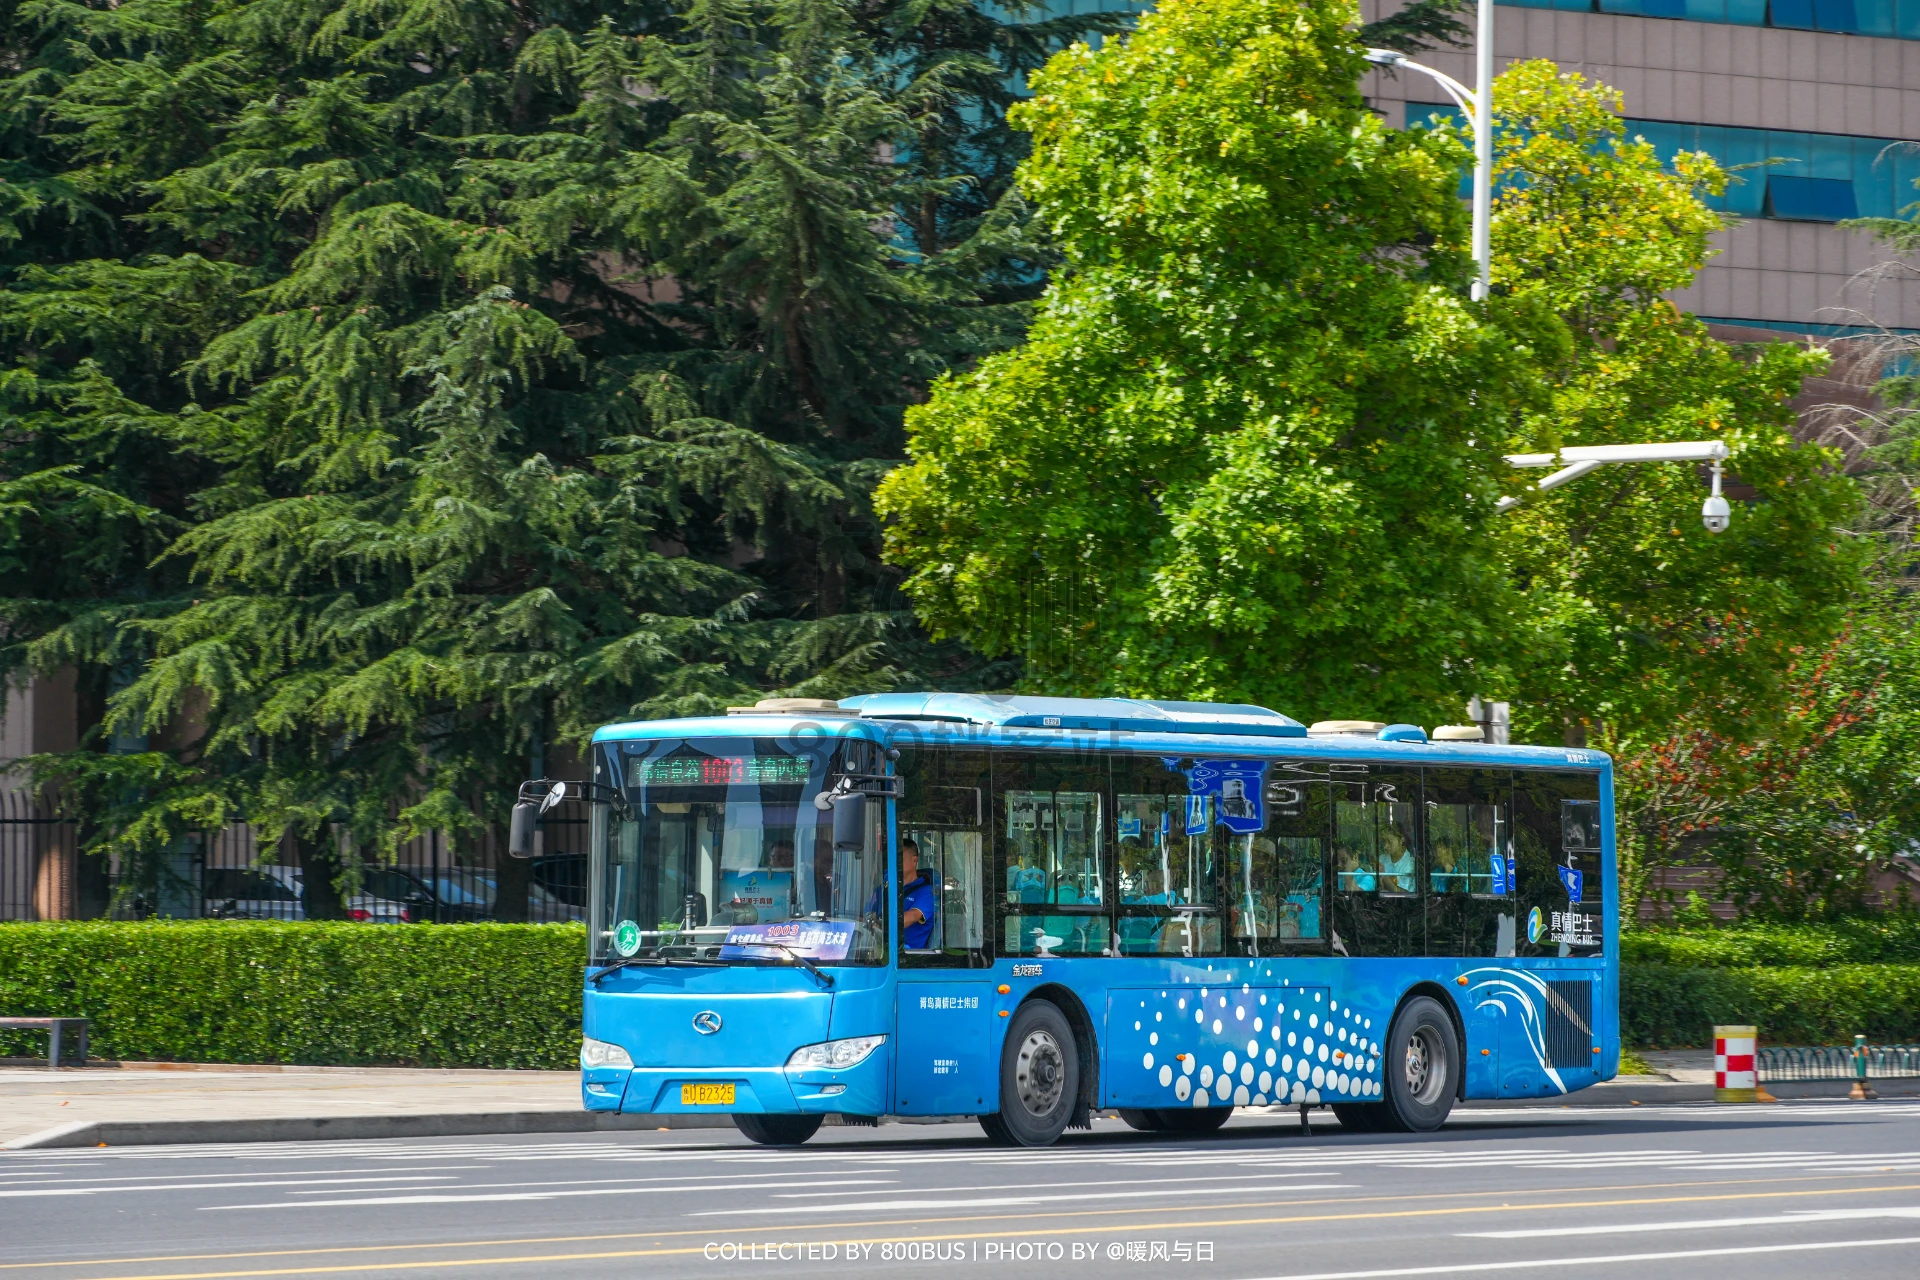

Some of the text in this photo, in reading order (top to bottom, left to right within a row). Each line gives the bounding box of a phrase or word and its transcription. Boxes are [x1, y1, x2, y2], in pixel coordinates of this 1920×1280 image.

[702, 758, 743, 783] 1003
[1551, 911, 1593, 932] 真情巴士
[767, 924, 799, 937] 1003
[1550, 932, 1593, 944] ZHENQING BUS
[920, 996, 979, 1010] 青岛真情巴士集团
